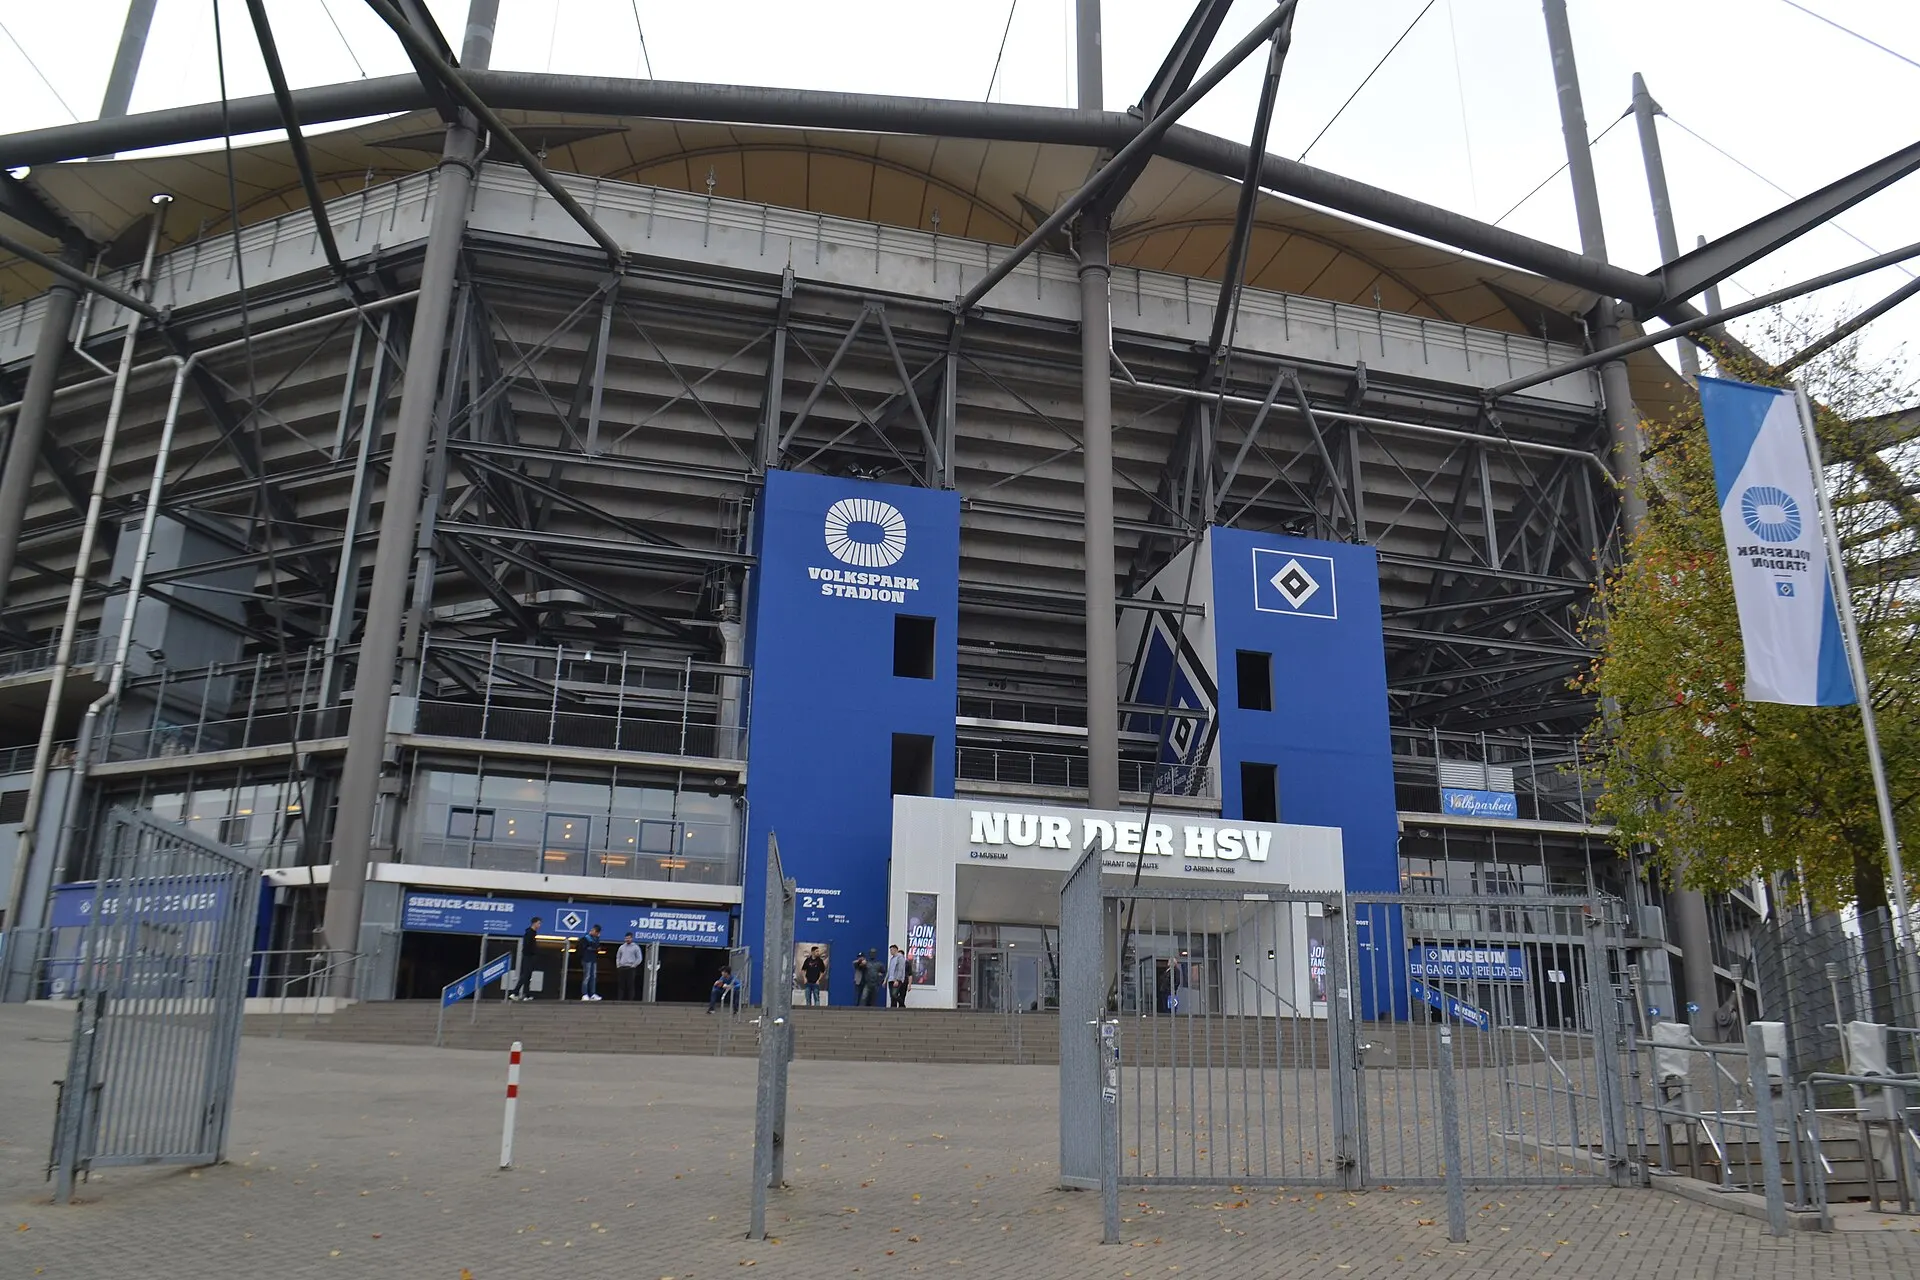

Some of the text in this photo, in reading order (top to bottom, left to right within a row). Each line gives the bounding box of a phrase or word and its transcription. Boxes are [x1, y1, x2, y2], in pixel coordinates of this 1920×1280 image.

[808, 567, 920, 591] VOLKSPARK
[821, 583, 905, 604] STADION
[1445, 793, 1514, 816] Volksparkett
[970, 810, 1272, 862] NUR DER HSV
[979, 852, 1008, 860] MUSEUM
[1102, 859, 1125, 868] URANT
[1140, 862, 1160, 870] AUTE
[1193, 865, 1236, 875] ARENA STORE
[795, 887, 813, 895] GANG
[408, 896, 515, 913] SERVICE-CENTER
[803, 896, 825, 909] 2-1
[635, 931, 719, 943] EINGANG AN SPIELTAGEN
[909, 925, 934, 938] JOIN
[908, 938, 934, 947] TANGO
[908, 948, 934, 957] LEAGUE
[1310, 946, 1325, 958] JOI
[1441, 950, 1506, 964] MUSEUM
